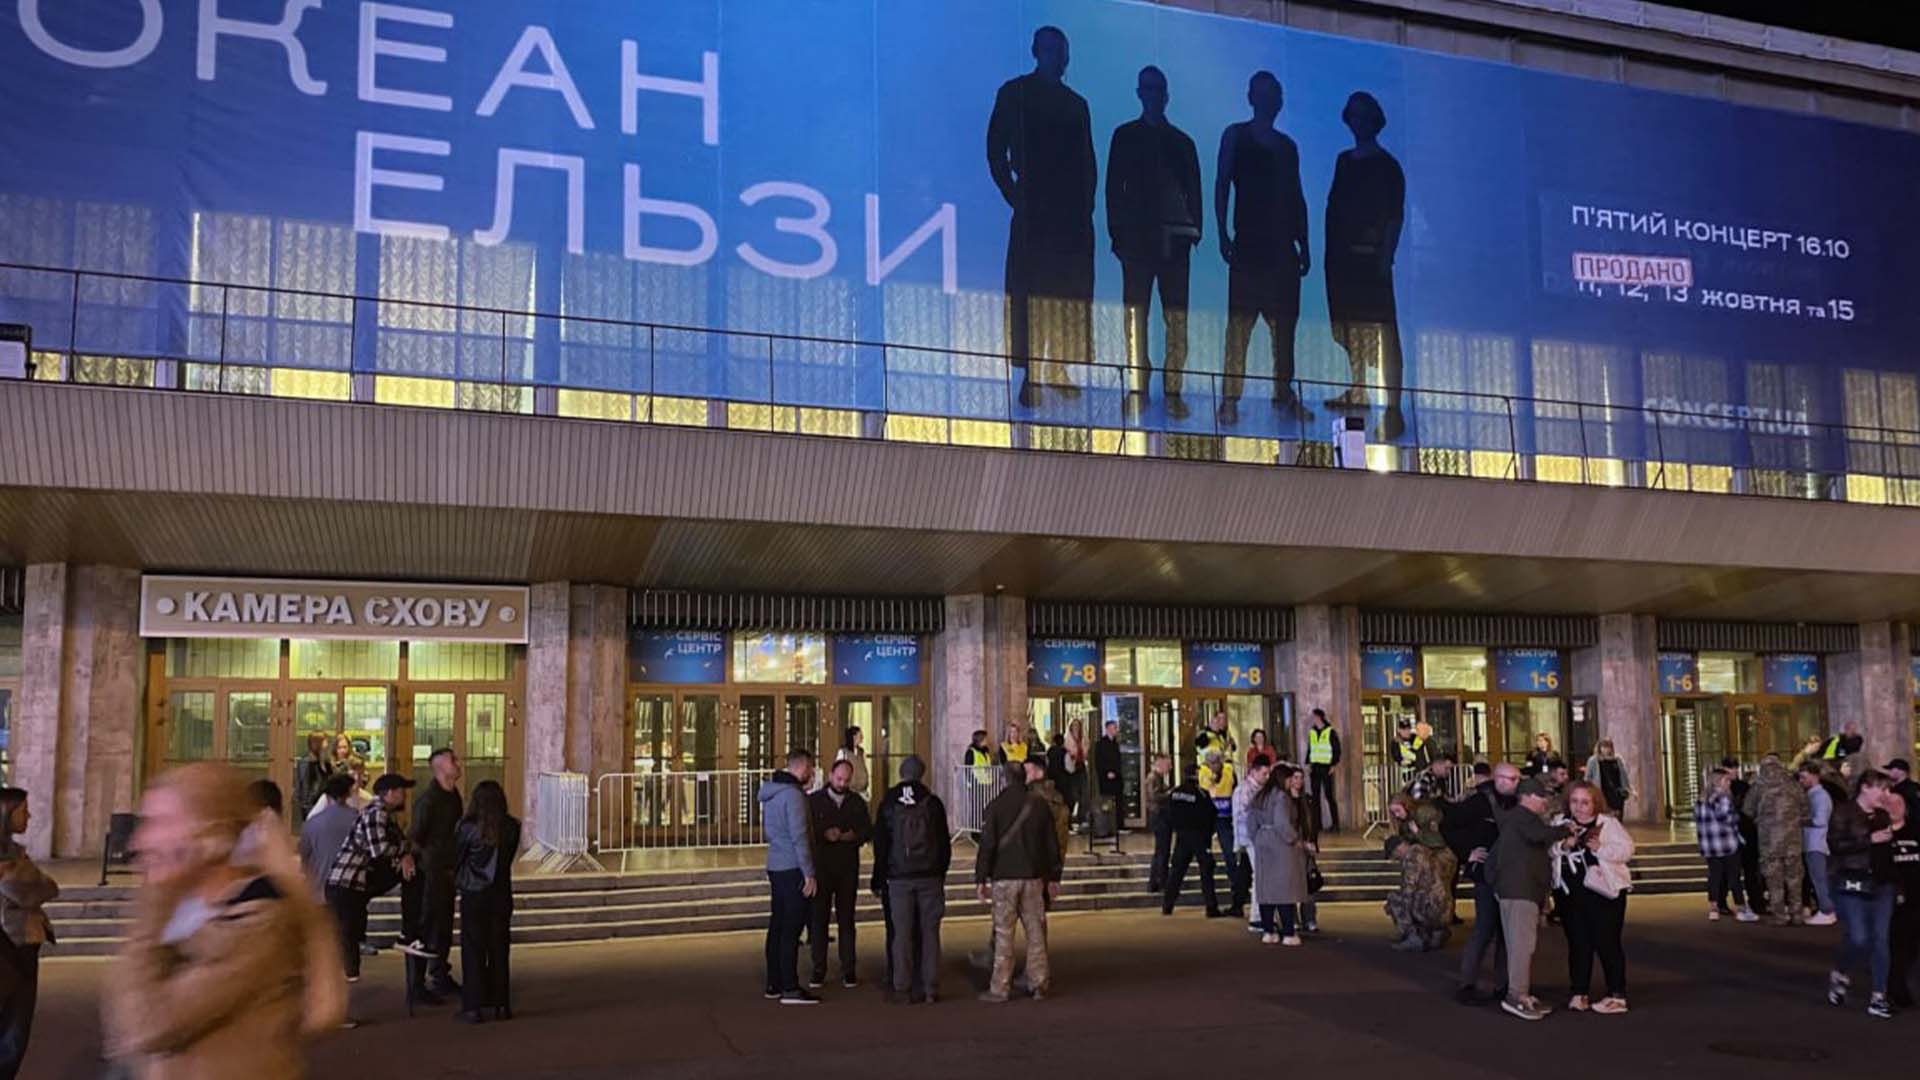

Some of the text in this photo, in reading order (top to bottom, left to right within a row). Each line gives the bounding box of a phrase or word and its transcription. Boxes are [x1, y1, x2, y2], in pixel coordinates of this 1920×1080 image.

[18, 0, 719, 145] ОКЕАН
[354, 130, 957, 295] ЕЛЬЗИ
[1572, 206, 1850, 259] П'ЯТИЙ КОНЦЕРТ 16.10
[1580, 256, 1686, 283] ПРОДАНО
[1828, 300, 1854, 320] 15
[183, 591, 492, 628] КАМЕРА СХОВУ
[676, 631, 722, 642] СЕРВІС
[1044, 638, 1097, 649] СЕКТОРИ
[678, 643, 722, 655] ЦЕНТР
[876, 646, 918, 658] ЦЕНТР
[1061, 664, 1096, 684] 7-8
[1227, 665, 1262, 686] 7-8
[1384, 668, 1414, 688] 1-6
[1530, 670, 1559, 689] 1-6
[1666, 674, 1693, 692] 1-6
[1794, 674, 1819, 691] 1-6
